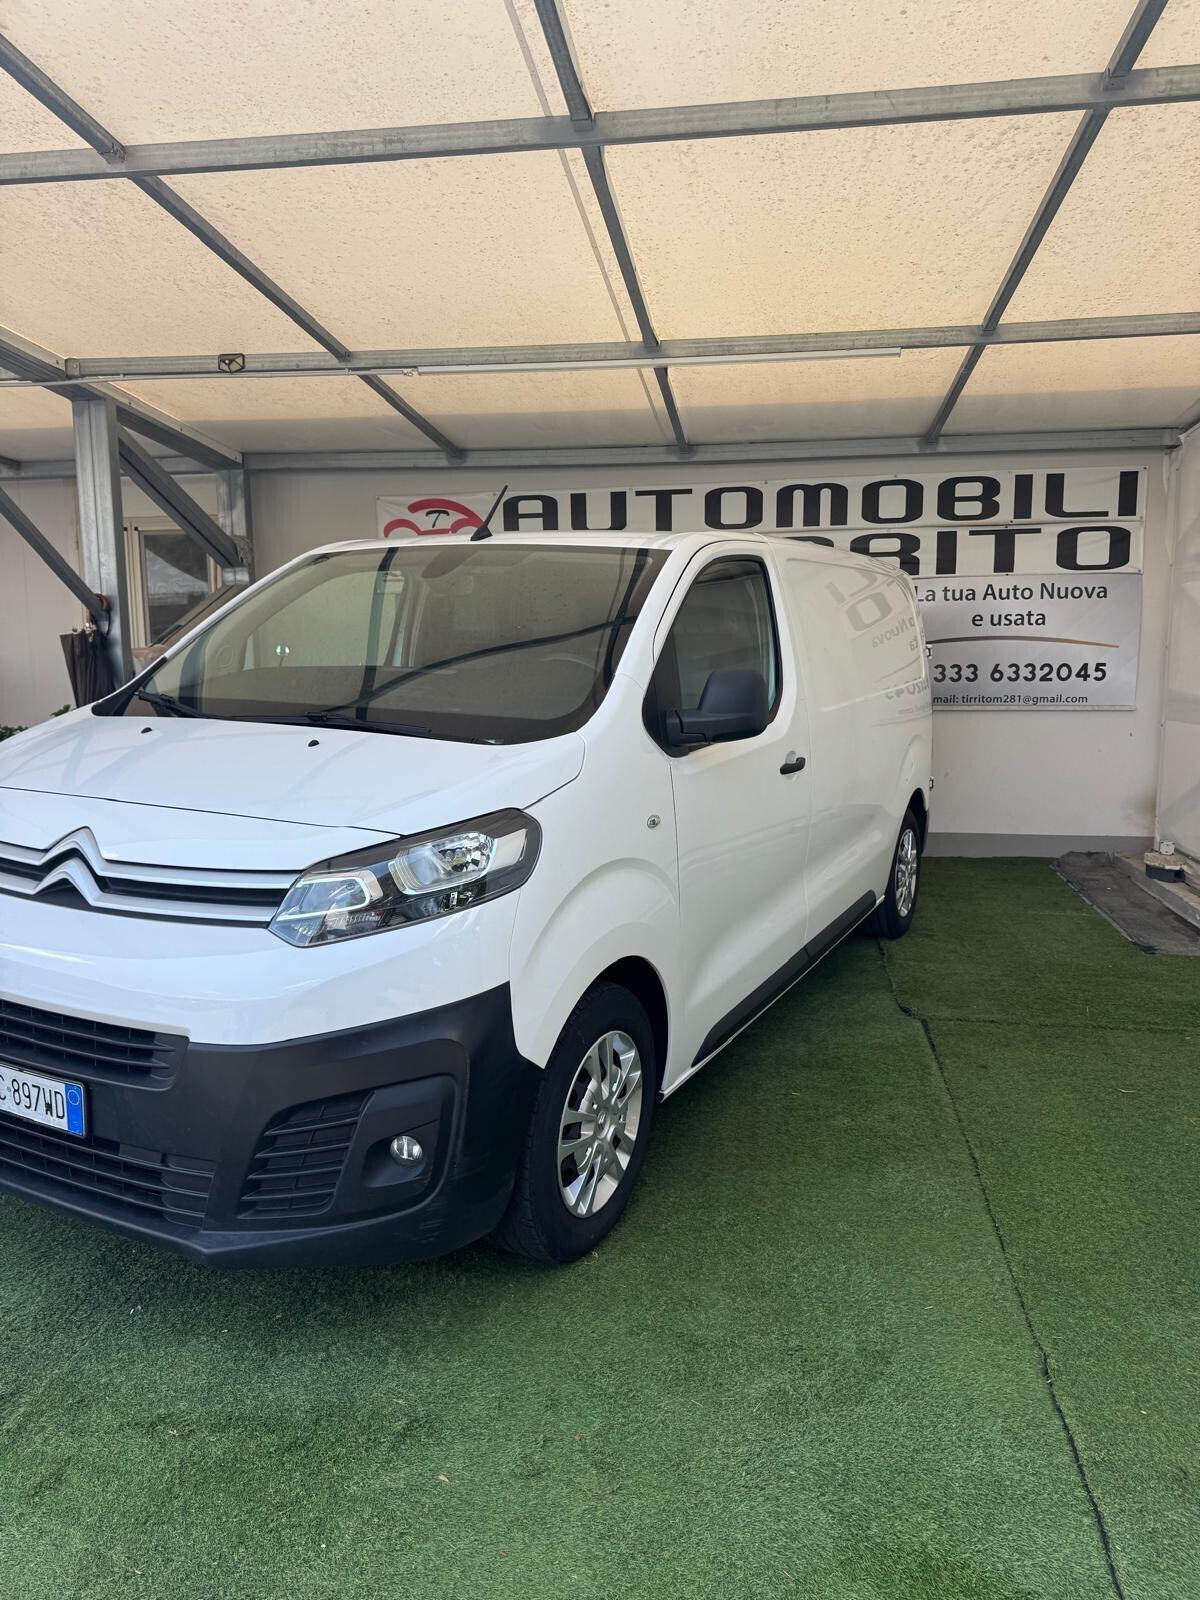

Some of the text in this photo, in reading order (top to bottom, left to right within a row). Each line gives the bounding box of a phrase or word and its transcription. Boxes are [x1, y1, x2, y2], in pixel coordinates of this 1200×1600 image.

[502, 470, 1140, 533] AUTOMOBILI
[785, 525, 1131, 576] RITO
[943, 587, 976, 601] tua
[982, 584, 1034, 600] Auto
[1040, 582, 1108, 600] Nuova
[971, 611, 1046, 627] e usata
[933, 662, 1107, 683] 333 6332045
[961, 694, 1088, 705] tirritom281@gmail.com
[11, 1078, 65, 1120] 897WD
